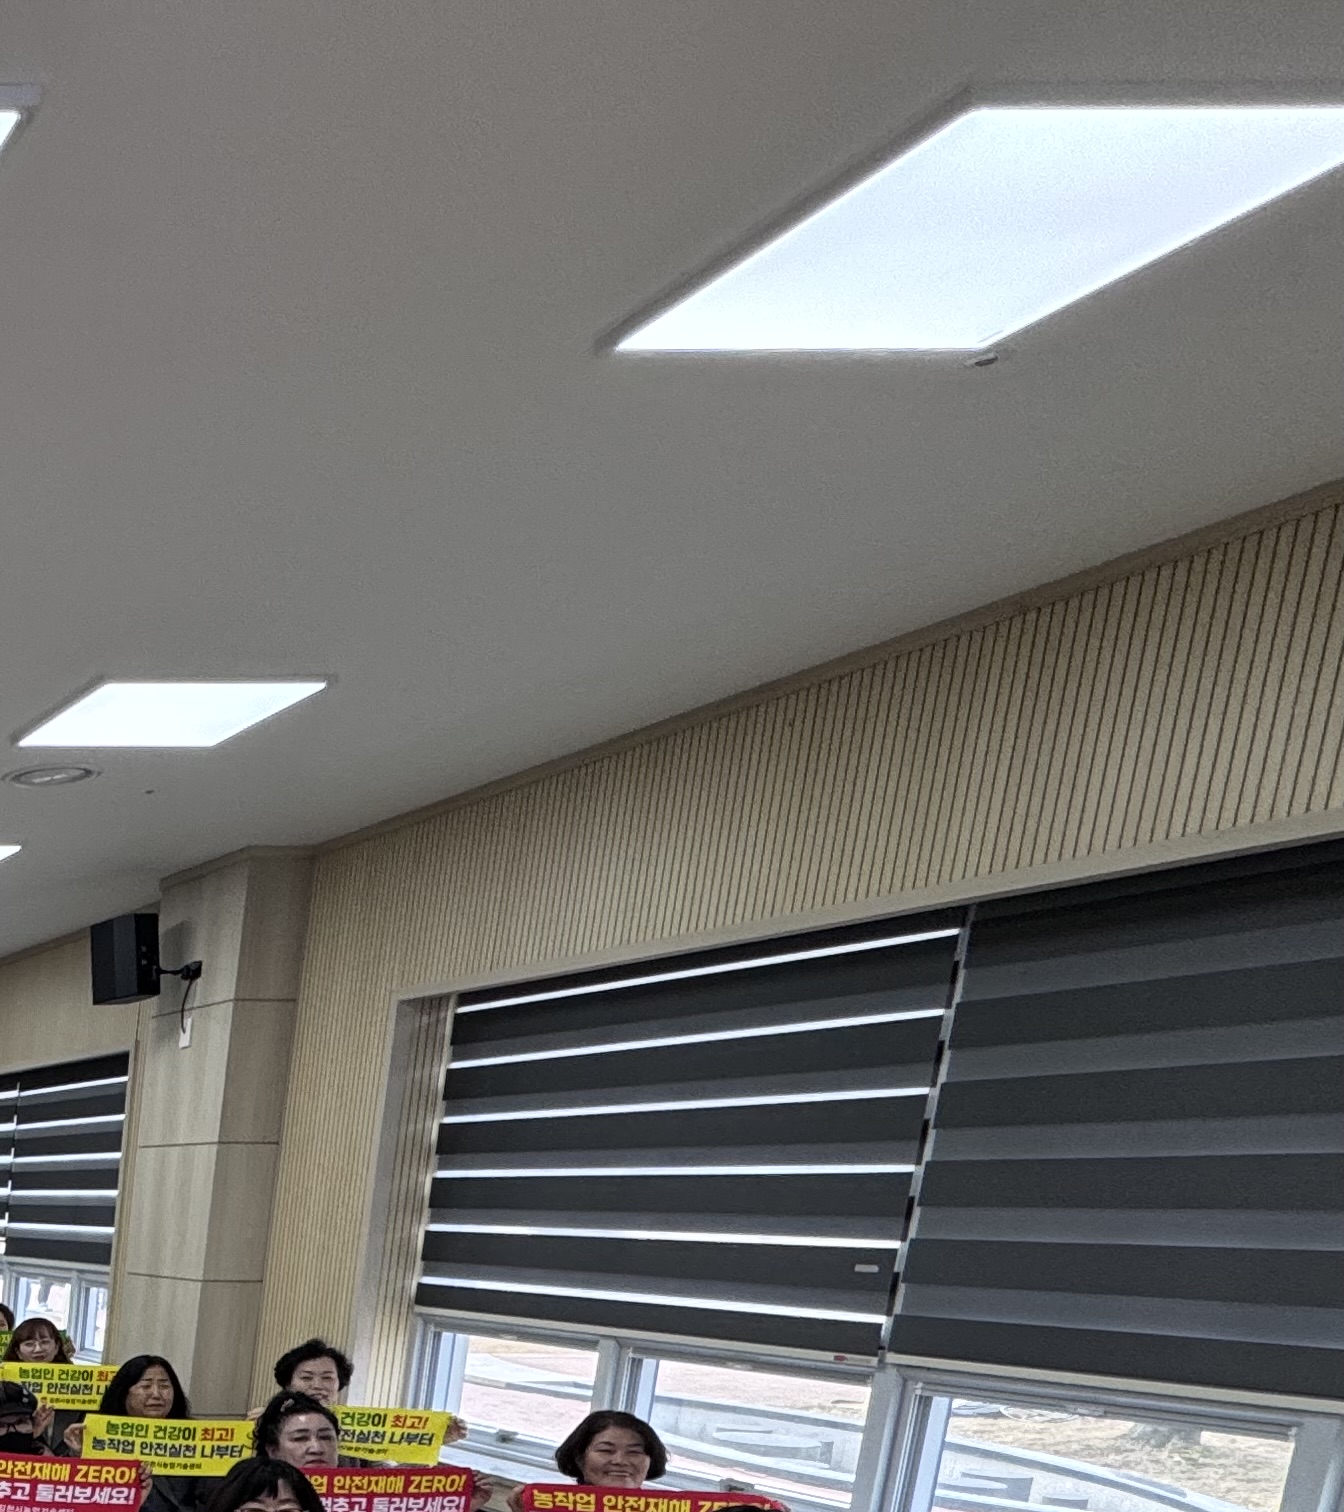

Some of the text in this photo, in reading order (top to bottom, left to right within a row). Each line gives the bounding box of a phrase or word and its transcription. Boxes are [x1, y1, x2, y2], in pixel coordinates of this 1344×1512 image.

[19, 1367, 93, 1382] 농업인 건강이
[47, 1382, 98, 1395] 안전실천
[340, 1411, 429, 1430] 건강이 최고!
[105, 1420, 235, 1442] 농업인 건강이 최고!
[389, 1432, 435, 1446] 나부터
[92, 1437, 244, 1458] 농작업 안전실천 나부터
[74, 1465, 136, 1484] ZERO!
[334, 1475, 405, 1494] 안전재해
[408, 1475, 467, 1493] ZERO!
[35, 1484, 136, 1505] 둘러보세요!
[533, 1489, 596, 1511] 농작업
